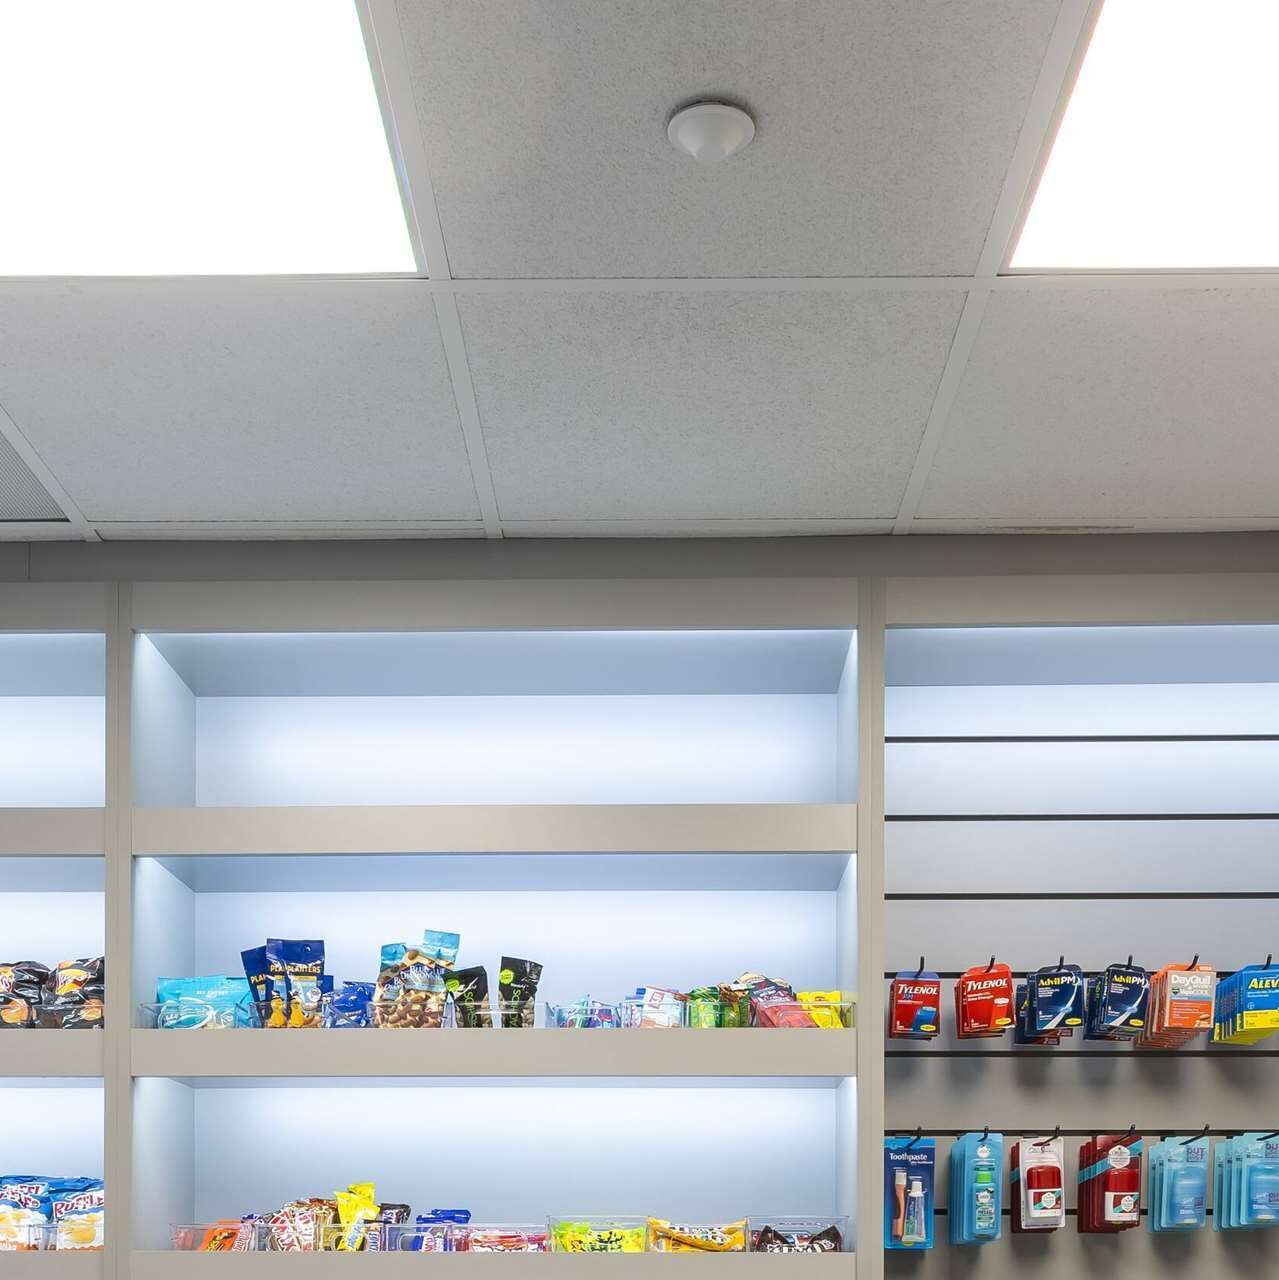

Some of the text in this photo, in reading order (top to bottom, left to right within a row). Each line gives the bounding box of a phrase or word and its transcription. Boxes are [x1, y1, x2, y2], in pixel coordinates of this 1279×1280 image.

[967, 978, 1008, 992] TYLENOL
[1038, 976, 1076, 988] Advil PM
[1112, 975, 1145, 985] Advil PM
[1171, 975, 1211, 986] DayQuil
[898, 984, 938, 995] TYLENOL
[889, 1152, 928, 1163] Toothpaste
